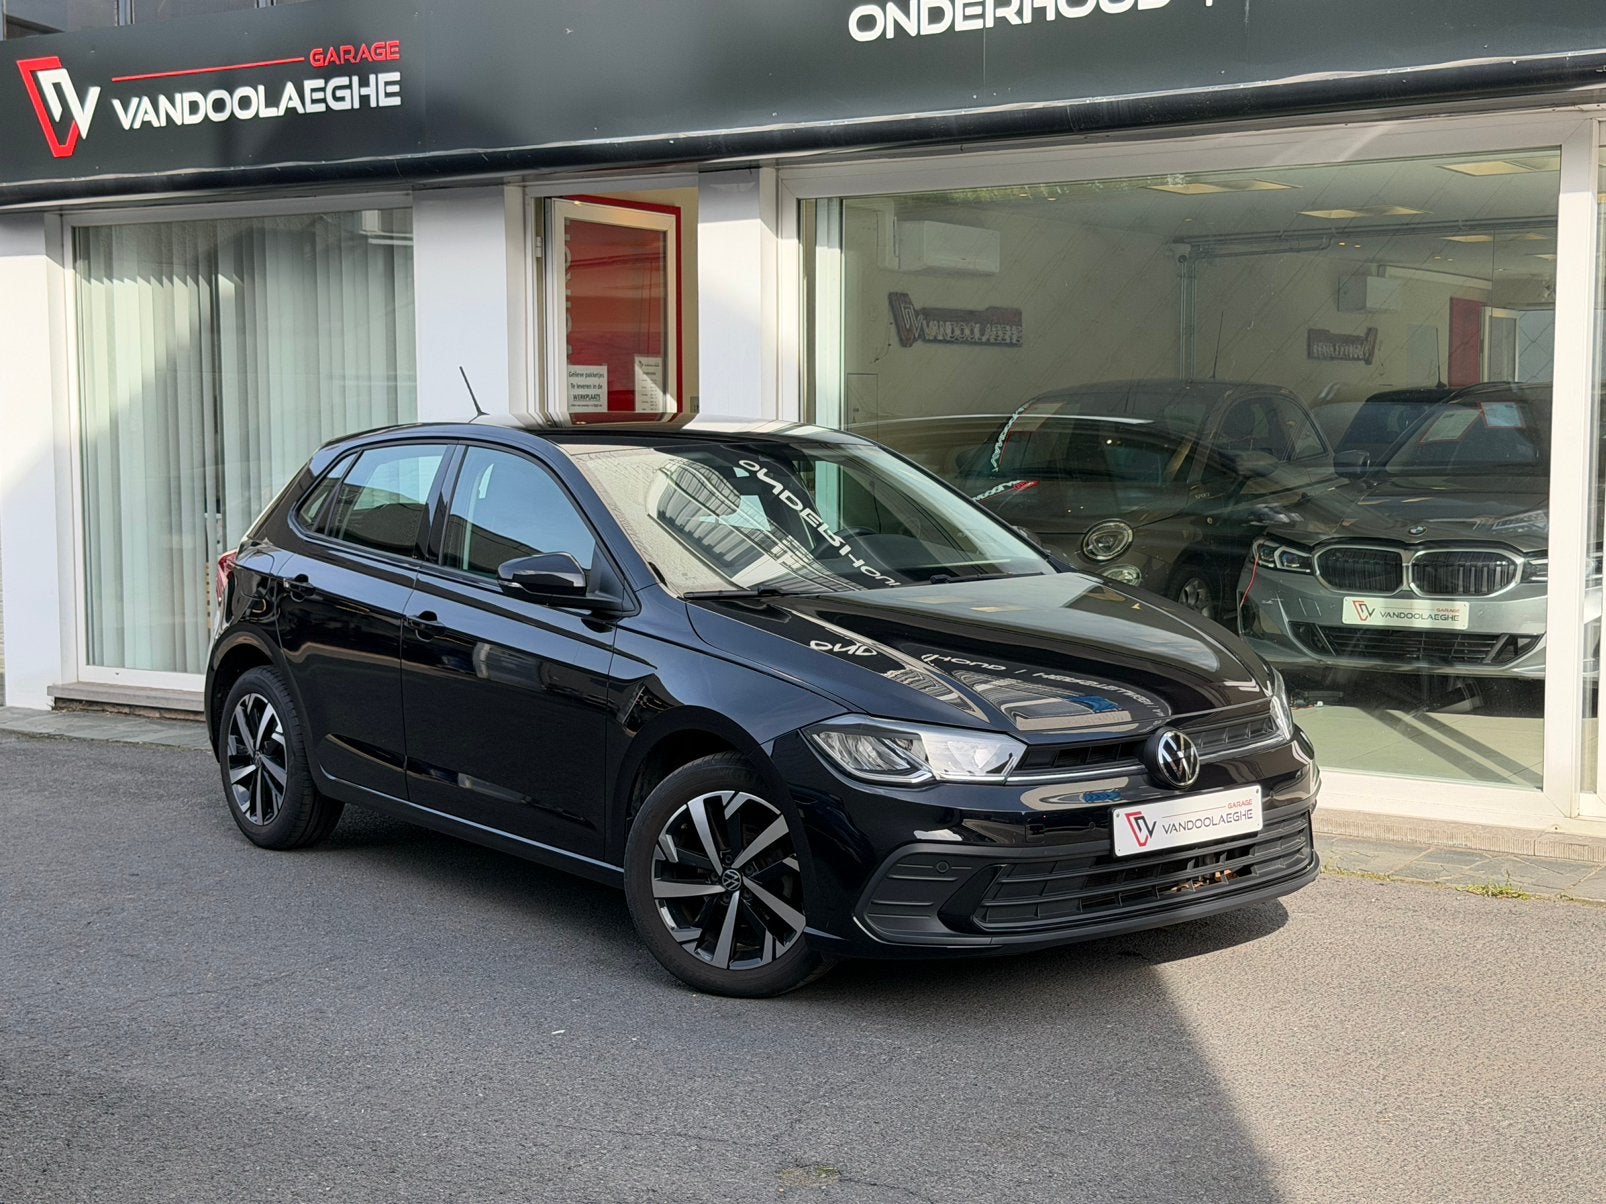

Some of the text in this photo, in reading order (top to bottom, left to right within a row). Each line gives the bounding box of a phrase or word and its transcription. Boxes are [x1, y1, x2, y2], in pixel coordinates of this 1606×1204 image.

[309, 40, 400, 68] GARAGE
[112, 72, 402, 131] VANDOOLAEGHE
[1380, 611, 1460, 621] VANDOOLAEGHE
[1227, 799, 1253, 809] GARAGE
[1162, 809, 1253, 835] VANDOOLAEGHE
